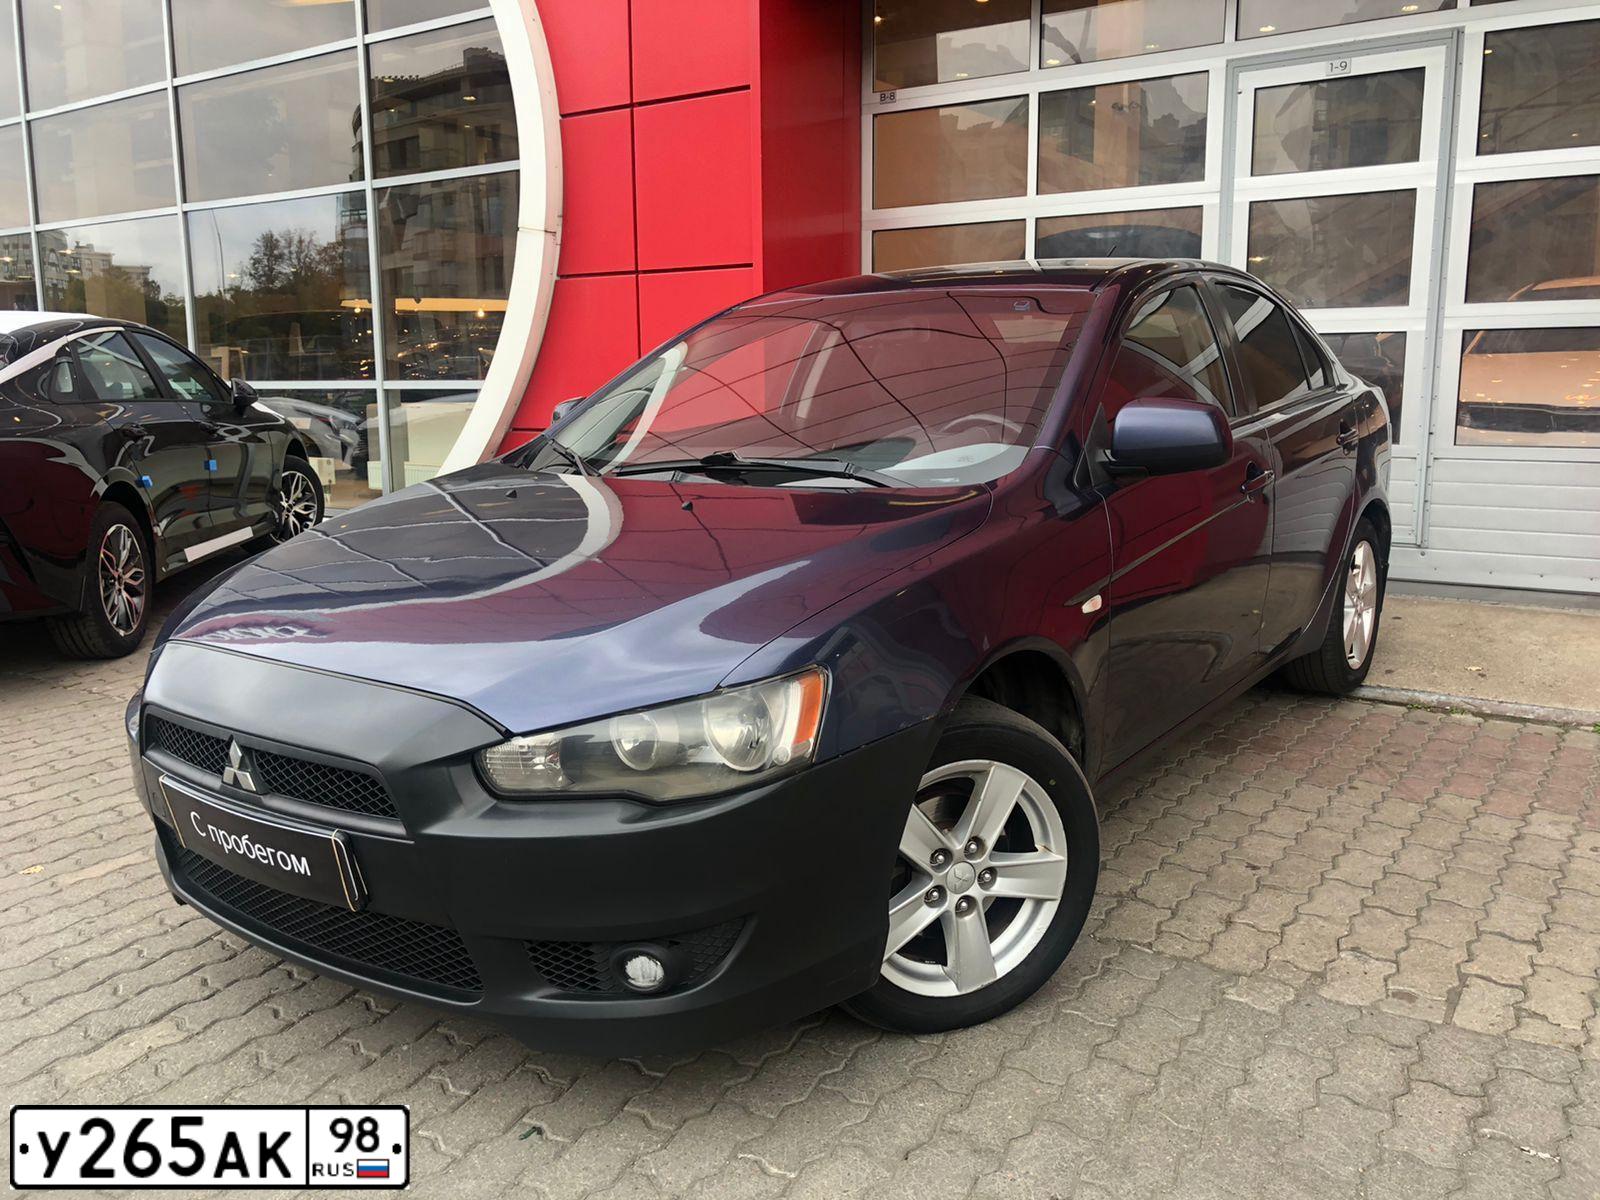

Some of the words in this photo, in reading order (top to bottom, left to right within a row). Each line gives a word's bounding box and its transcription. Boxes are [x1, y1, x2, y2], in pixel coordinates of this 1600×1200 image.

[1329, 61, 1347, 72] 1-9
[189, 811, 206, 837] С
[206, 825, 312, 876] пробегом
